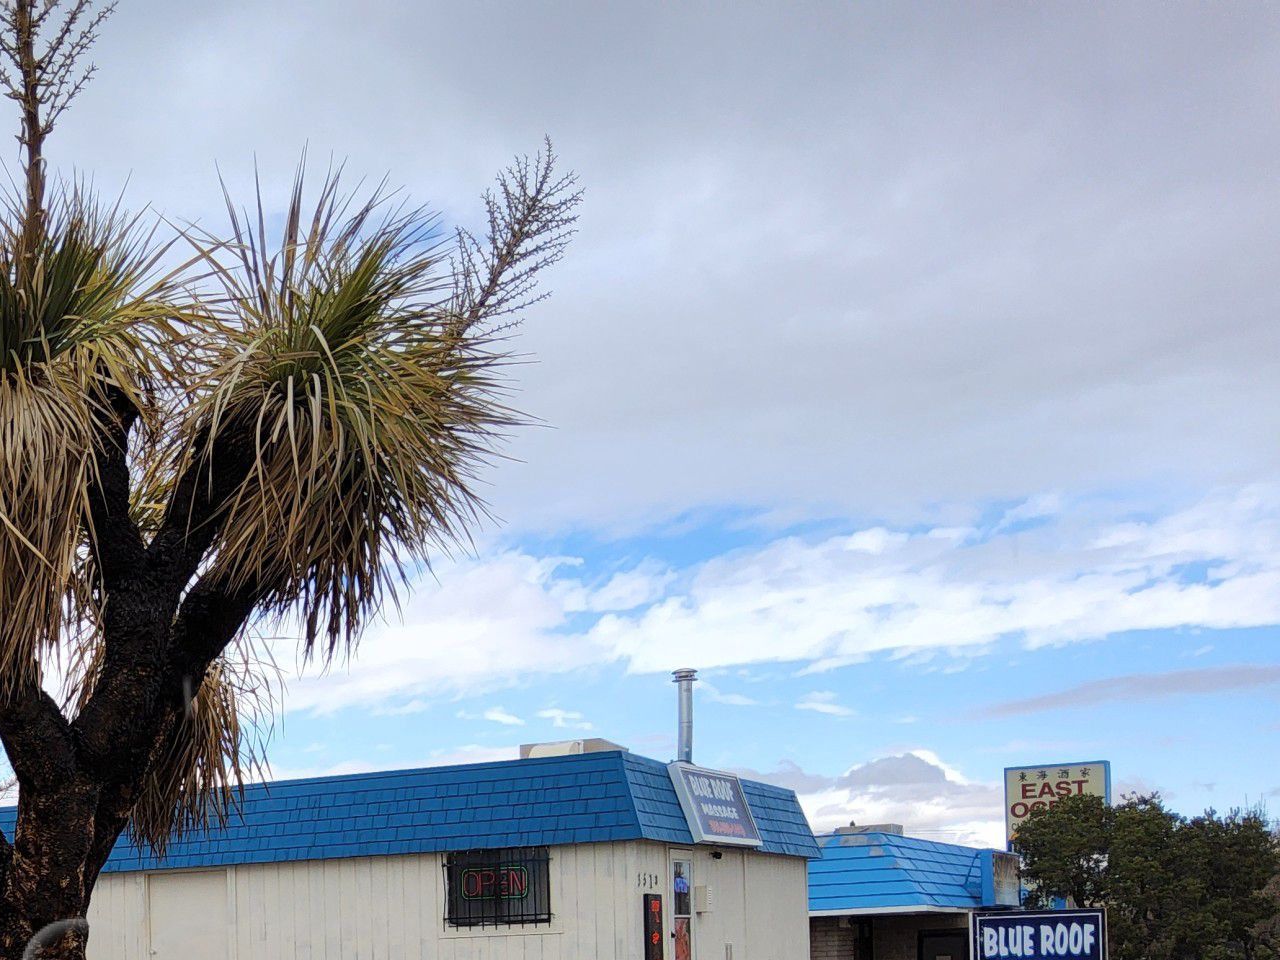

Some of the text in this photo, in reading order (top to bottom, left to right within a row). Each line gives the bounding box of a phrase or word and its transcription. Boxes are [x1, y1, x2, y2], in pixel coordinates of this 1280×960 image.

[1021, 780, 1089, 799] EAST
[463, 870, 526, 896] OPEN
[983, 922, 1096, 957] BLUE ROOF
